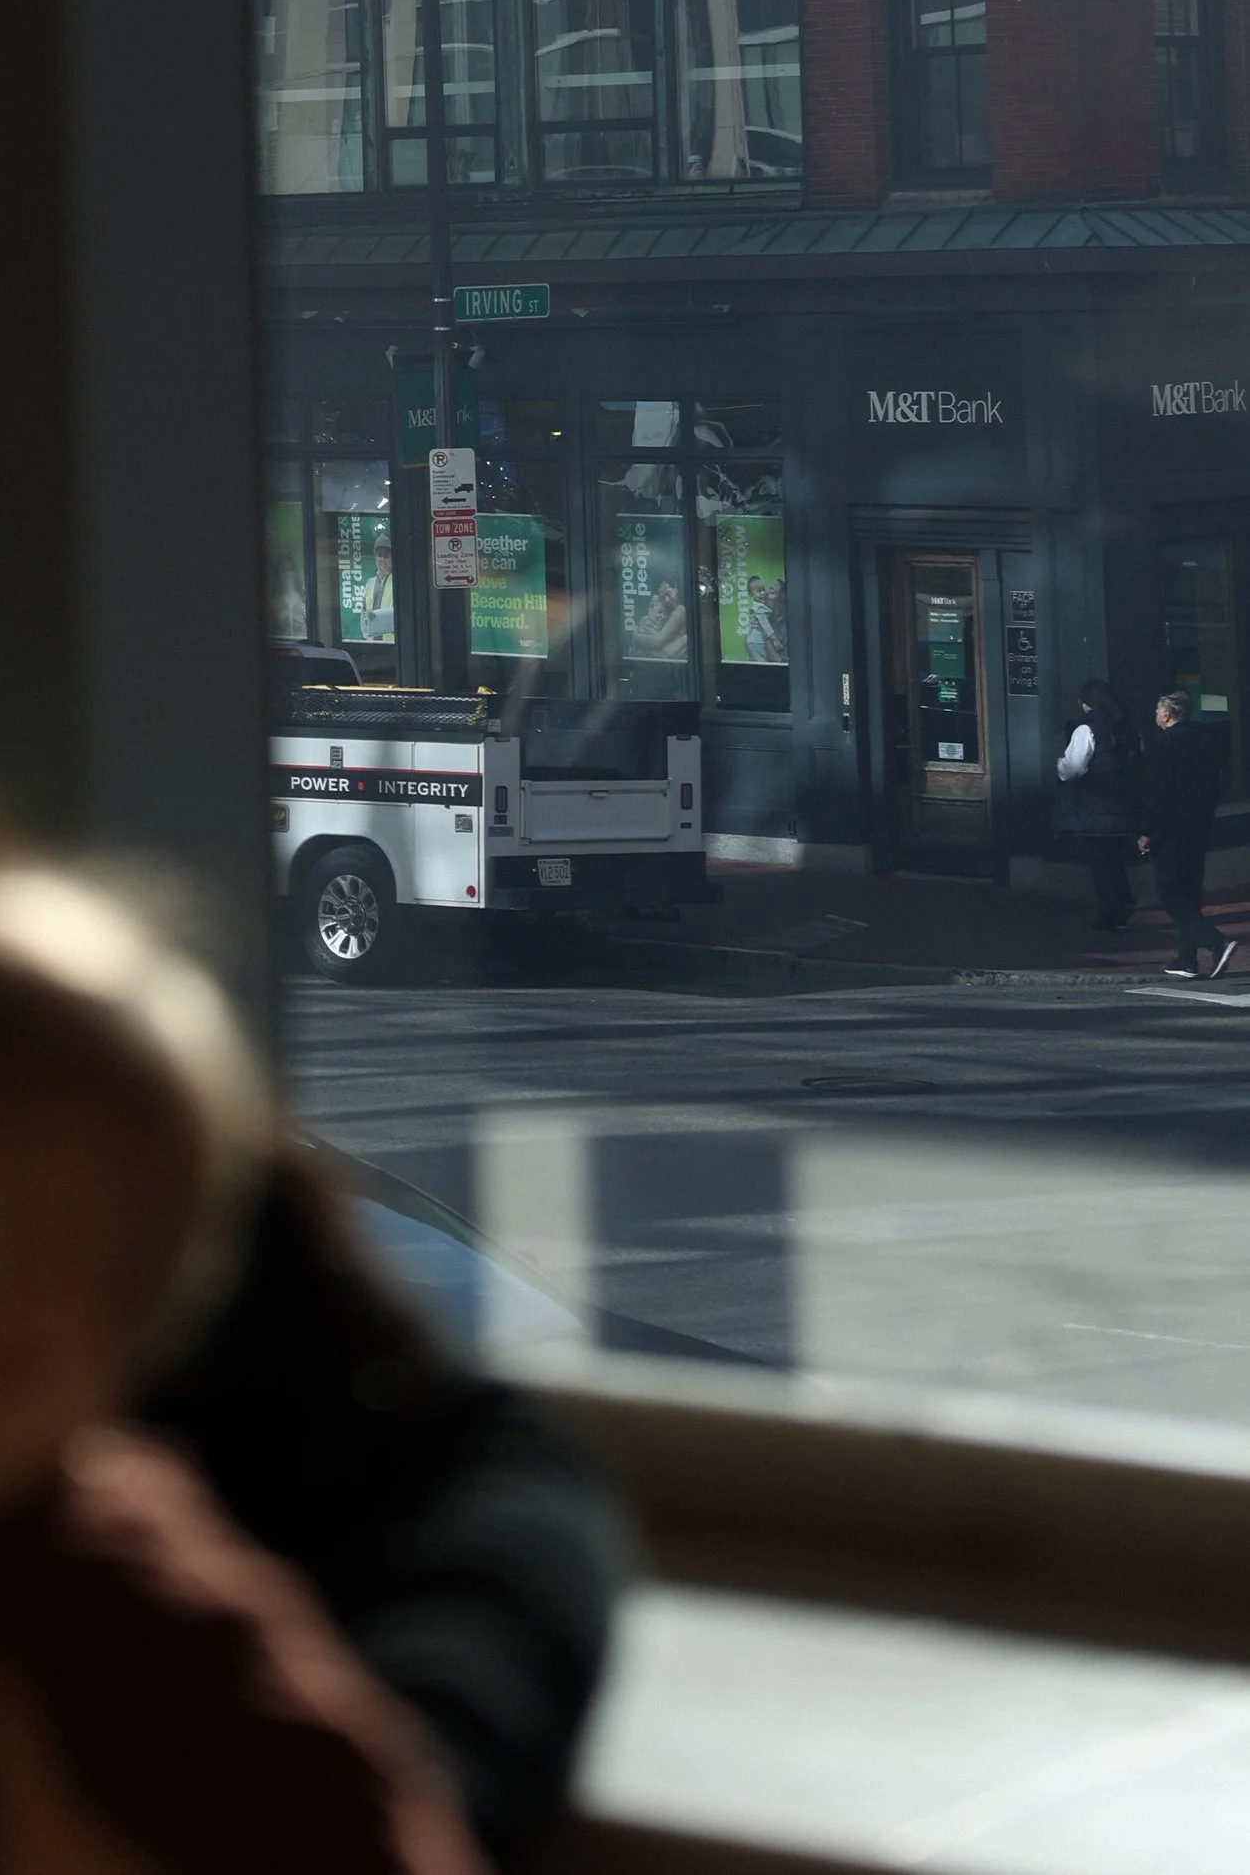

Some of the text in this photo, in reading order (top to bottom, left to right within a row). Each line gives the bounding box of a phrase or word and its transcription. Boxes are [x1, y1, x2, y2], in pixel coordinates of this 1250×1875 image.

[465, 289, 539, 316] IRVING ST
[938, 391, 1003, 424] Bank
[1201, 380, 1247, 413] Bank
[435, 522, 474, 534] TOW ZONE
[338, 528, 351, 556] biz
[477, 534, 529, 554] ogether
[351, 516, 366, 614] big dreams
[491, 557, 517, 571] can
[633, 522, 651, 596] people
[338, 559, 353, 610] small
[621, 542, 638, 631] purpose
[471, 592, 547, 610] Beacon Hill
[471, 613, 529, 630] forward.
[290, 776, 469, 798] POWER INTEGRITY
